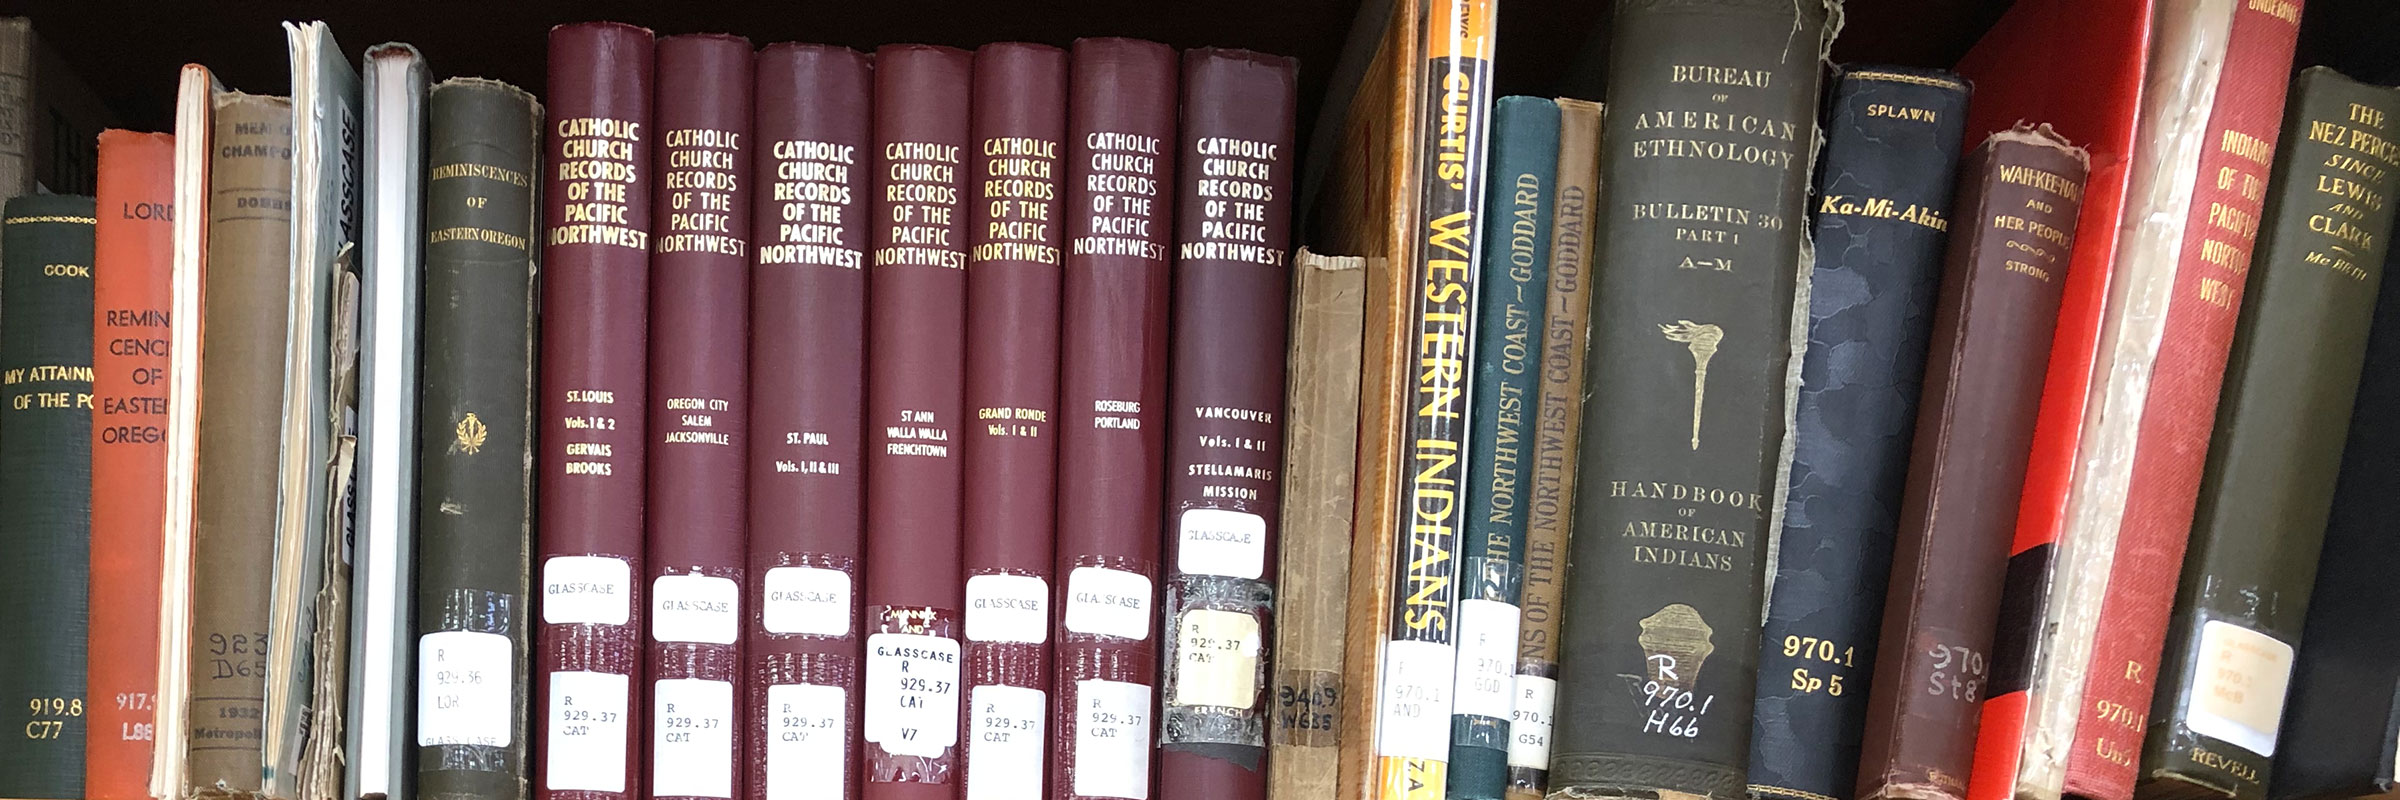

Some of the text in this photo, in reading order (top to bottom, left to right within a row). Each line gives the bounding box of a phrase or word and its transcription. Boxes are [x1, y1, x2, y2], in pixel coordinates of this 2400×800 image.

[1671, 65, 1772, 89] BUREAU
[1712, 93, 1729, 103] OF
[1867, 104, 1936, 123] SPLAWN
[2349, 102, 2385, 130] THE
[558, 118, 639, 141] CATHOLIC
[1634, 111, 1797, 142] AMERICAN
[2309, 120, 2347, 146] NEZ
[666, 129, 739, 150] CATHOLIC
[984, 137, 1057, 160] CATHOLIC
[1087, 132, 1160, 155] CATHOLIC
[1197, 137, 1277, 161] CATHOLIC
[562, 140, 633, 161] CHURCH
[670, 151, 733, 170] CHURCH
[773, 141, 855, 165] CATHOLIC
[886, 142, 959, 164] CATHOLIC
[1633, 139, 1795, 170] ETHNOLOGY
[559, 160, 636, 183] RECORDS
[777, 162, 848, 184] CHURCH
[891, 163, 953, 183] CHURCH
[988, 158, 1050, 179] CHURCH
[1092, 153, 1154, 175] CHURCH
[1203, 158, 1270, 181] CHURCH
[432, 163, 528, 187] REMINISCENCES
[667, 171, 737, 192] RECORDS
[1088, 174, 1157, 196] RECORDS
[2217, 166, 2238, 191] OF
[567, 182, 626, 203] OF THE
[774, 183, 851, 205] RECORDS
[887, 184, 957, 205] RECORDS
[984, 179, 1054, 201] RECORDS
[1198, 179, 1273, 202] RECORDS
[466, 197, 487, 209] OF
[672, 192, 731, 212] OF THE
[990, 200, 1048, 221] OF THE
[1093, 195, 1151, 216] OF THE
[1205, 200, 1264, 223] OF THE
[2026, 200, 2053, 214] AND
[2328, 203, 2364, 220] AND
[565, 203, 627, 224] PACIFIC
[671, 213, 729, 233] PACIFIC
[782, 203, 841, 224] OF THE
[893, 205, 951, 225] OF THE
[1632, 203, 1784, 231] BULLETIN 30
[1819, 195, 1948, 232] Ka-Mi-Akin
[1994, 215, 2025, 230] HER
[780, 224, 844, 245] PACIFIC
[892, 226, 950, 246] PACIFIC
[988, 222, 1047, 242] PACIFIC
[1092, 216, 1149, 237] PACIFIC
[1202, 221, 1266, 243] PACIFIC
[1675, 228, 1727, 245] PART
[2309, 214, 2373, 251] CLARK
[430, 227, 526, 250] EASTERN OREGON
[548, 225, 648, 250] NORTHWEST
[655, 234, 747, 257] NORTHWEST
[760, 245, 863, 270] NORTHWEST
[875, 247, 967, 270] NORTHWEST
[972, 244, 1061, 266] NORTHWEST
[1074, 237, 1165, 261] NORTHWEST
[1180, 242, 1284, 267] NORTHWEST
[44, 264, 90, 278] COOK
[2005, 259, 2050, 283] STRONG
[1404, 70, 1471, 632] CURTIS' WESTERN INDIANS
[4, 366, 26, 385] MY
[132, 368, 163, 385] OF
[14, 393, 71, 410] OF THE
[582, 390, 614, 404] LOUIS
[667, 398, 729, 411] OREGON CITY
[1095, 400, 1140, 414] ROSEBURG
[607, 418, 616, 430] 2
[681, 415, 712, 427] SALEM
[901, 410, 934, 423] ST ANN
[979, 407, 1046, 422] GRAND RONDE
[1094, 417, 1140, 431] PORTLAND
[1195, 407, 1272, 424] VANCOUVER
[665, 431, 729, 445] JACKSONVILLE
[786, 432, 829, 446] ST. PAUL
[887, 427, 948, 441] WALLA WALLA
[988, 424, 1008, 436] Vols.
[566, 443, 612, 457] GERVAIS
[887, 443, 947, 458] FRENCHTOWN
[1199, 435, 1231, 448] Vols.
[1490, 381, 1524, 527] NORTHWEST
[1534, 392, 1569, 532] NORTHWEST
[565, 462, 612, 476] BROOKS
[776, 460, 839, 475] Vols. III
[1188, 464, 1273, 481] STELLAMARIS
[1203, 486, 1257, 501] MISSION
[1610, 480, 1764, 512] HANDBOOK
[1678, 508, 1696, 518] OF
[1622, 521, 1746, 549] AMERICAN
[1529, 540, 1556, 587] THE
[1633, 547, 1733, 572] INDIANS
[1526, 593, 1550, 623] OF
[1192, 624, 1199, 634] R
[438, 648, 445, 662] R
[878, 647, 953, 663] GLASSCASE
[1783, 635, 1855, 668] 970.1
[901, 660, 909, 673] R
[1647, 654, 1679, 681] R
[2124, 660, 2141, 683] R
[1791, 668, 1844, 697] Sp 5
[564, 696, 573, 706] R
[1093, 698, 1102, 709] R
[1525, 689, 1534, 699] R
[1643, 680, 1714, 715] 970.1
[30, 698, 83, 717] 919.8
[564, 711, 617, 723] 929.37
[667, 703, 675, 713] R
[783, 704, 791, 713] R
[986, 703, 995, 714] R
[2096, 700, 2144, 733] 970.1
[667, 717, 719, 729] 929.37
[783, 717, 834, 729] 929.37
[985, 717, 1036, 730] 929.37
[1512, 710, 1553, 727] 970.1
[1643, 710, 1699, 738] H66
[25, 721, 63, 740] C77
[666, 732, 691, 743] CAT
[901, 728, 918, 741] V7
[983, 731, 1011, 743] CAT
[1091, 727, 1118, 738] CAT
[1518, 734, 1544, 747] G54
[2191, 747, 2261, 785] REVELL
